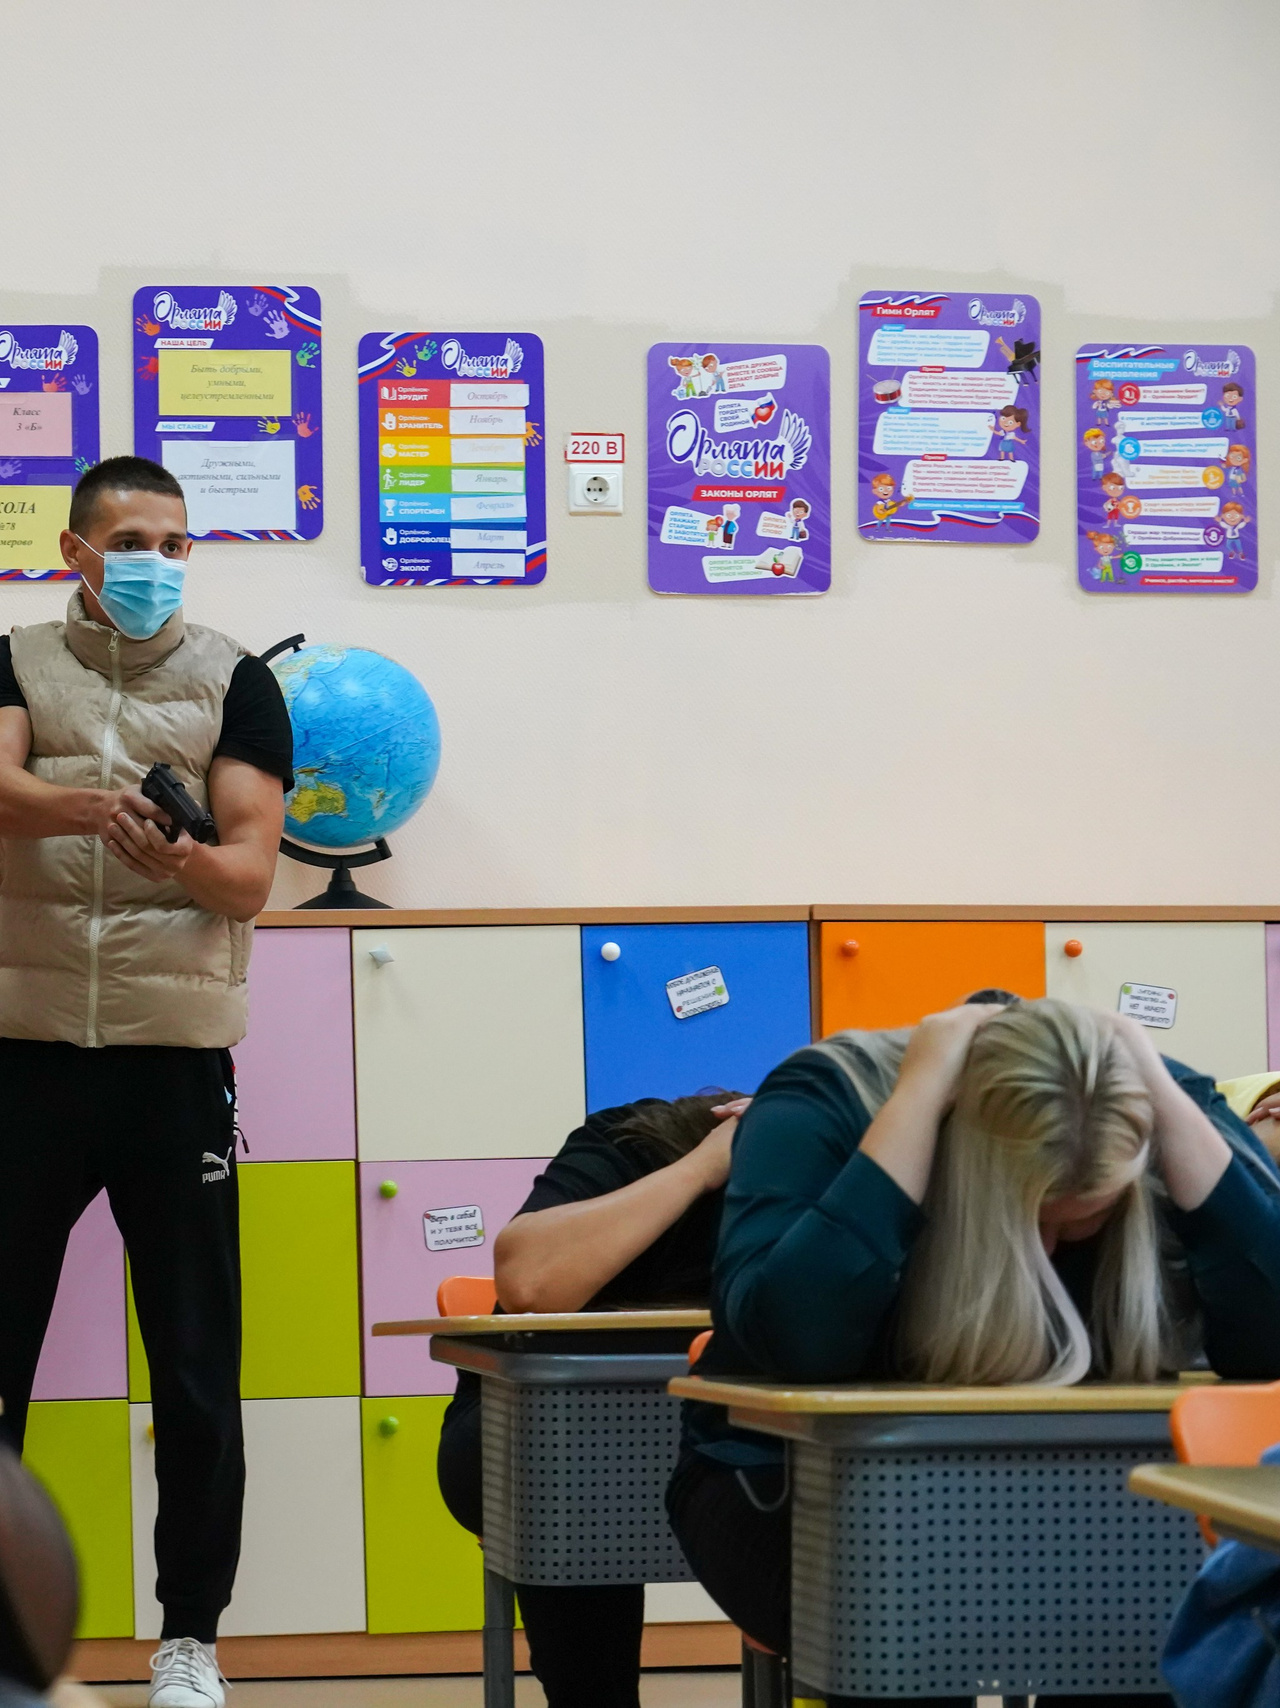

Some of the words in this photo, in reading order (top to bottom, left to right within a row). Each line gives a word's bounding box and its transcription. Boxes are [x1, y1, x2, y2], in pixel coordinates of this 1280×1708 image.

[154, 291, 221, 324] Орлята
[876, 307, 902, 316] Гимн
[903, 308, 936, 318] Орлят
[443, 339, 509, 371] Орлята
[190, 364, 218, 374] Быть
[1093, 360, 1175, 370] Воспитательные
[1092, 371, 1158, 380] направления
[12, 407, 42, 416] Класс
[469, 415, 503, 425] Ноябрь
[16, 422, 22, 431] 3
[669, 410, 786, 468] Орлята
[571, 440, 600, 455] 220
[606, 441, 618, 455] В
[697, 459, 784, 479] РОССИИ
[700, 489, 744, 498] ЗАКОНЫ
[745, 490, 778, 499] ОРЛЯТ
[202, 1169, 226, 1184] PUMA
